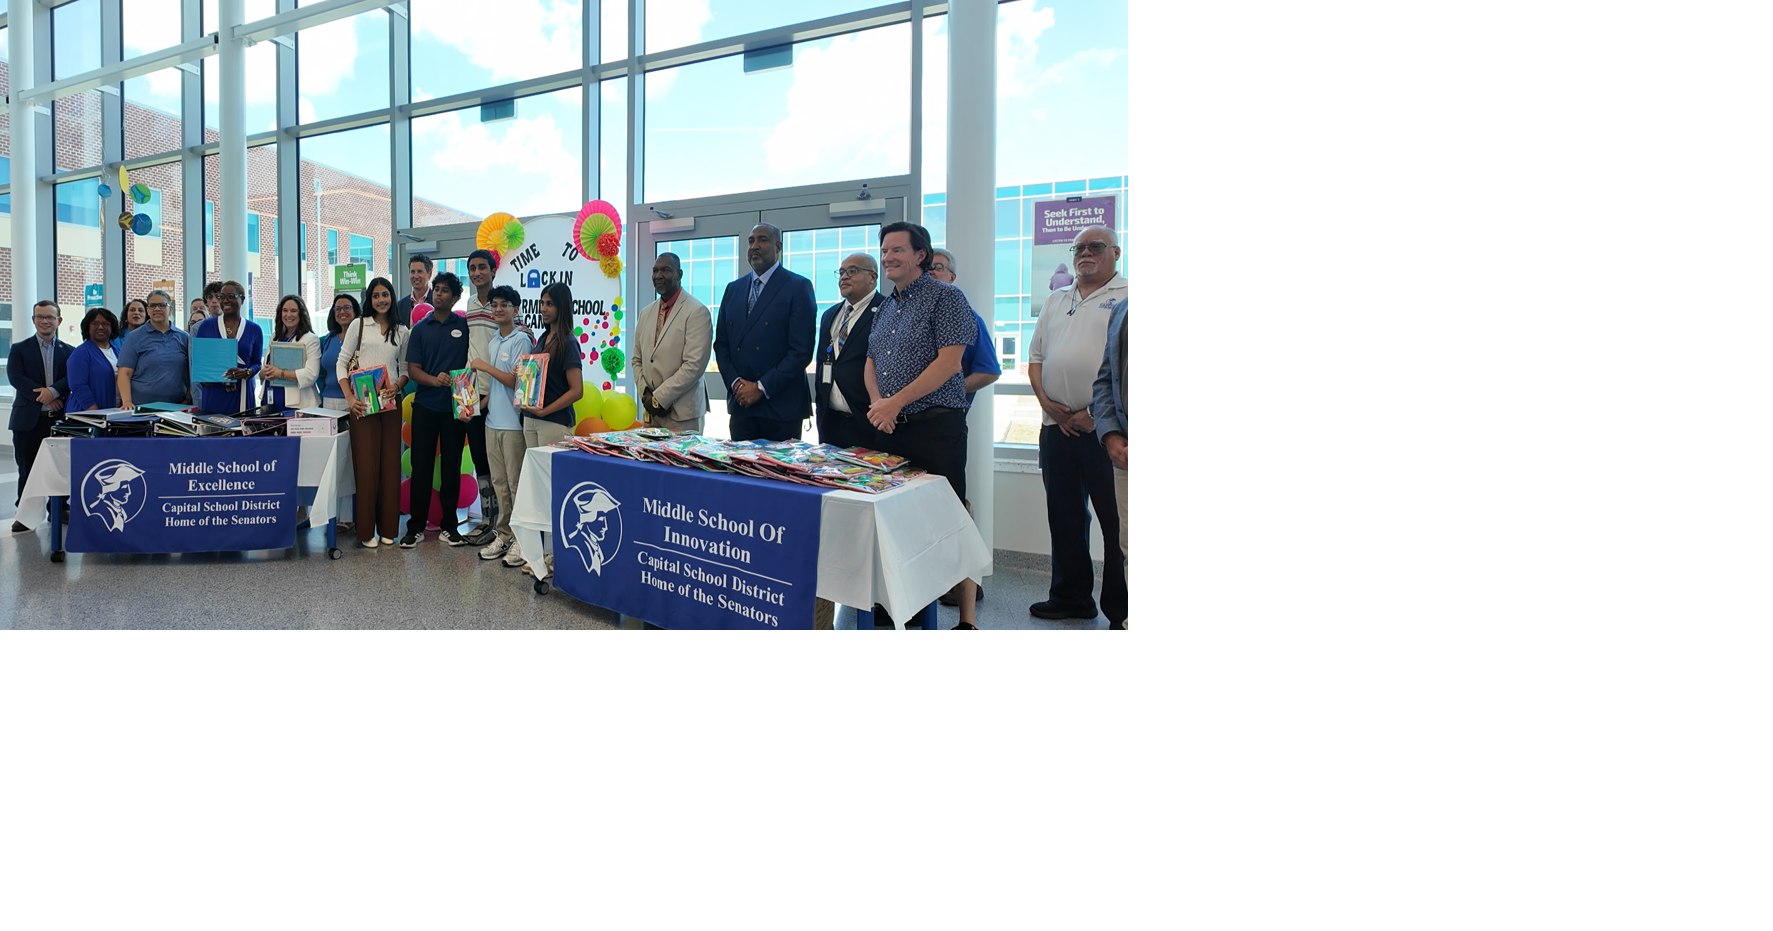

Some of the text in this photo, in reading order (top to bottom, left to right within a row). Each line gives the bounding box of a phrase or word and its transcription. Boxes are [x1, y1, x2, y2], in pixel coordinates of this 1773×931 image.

[1044, 207, 1105, 218] Seek First to
[1045, 215, 1105, 227] Understand,
[510, 241, 579, 272] TIME TO
[340, 277, 361, 285] Win-Win
[343, 270, 358, 278] Think
[559, 270, 573, 286] IN
[572, 299, 606, 316] CHOOL
[168, 460, 278, 475] Middle School of
[187, 479, 255, 492] Excellence
[162, 500, 281, 515] Capital School District
[164, 514, 277, 527] Home of the Senators
[643, 497, 786, 545] Middle School Of
[663, 526, 751, 564] Innovation
[637, 551, 785, 607] Capital School District
[641, 570, 779, 628] Home of the Senators
